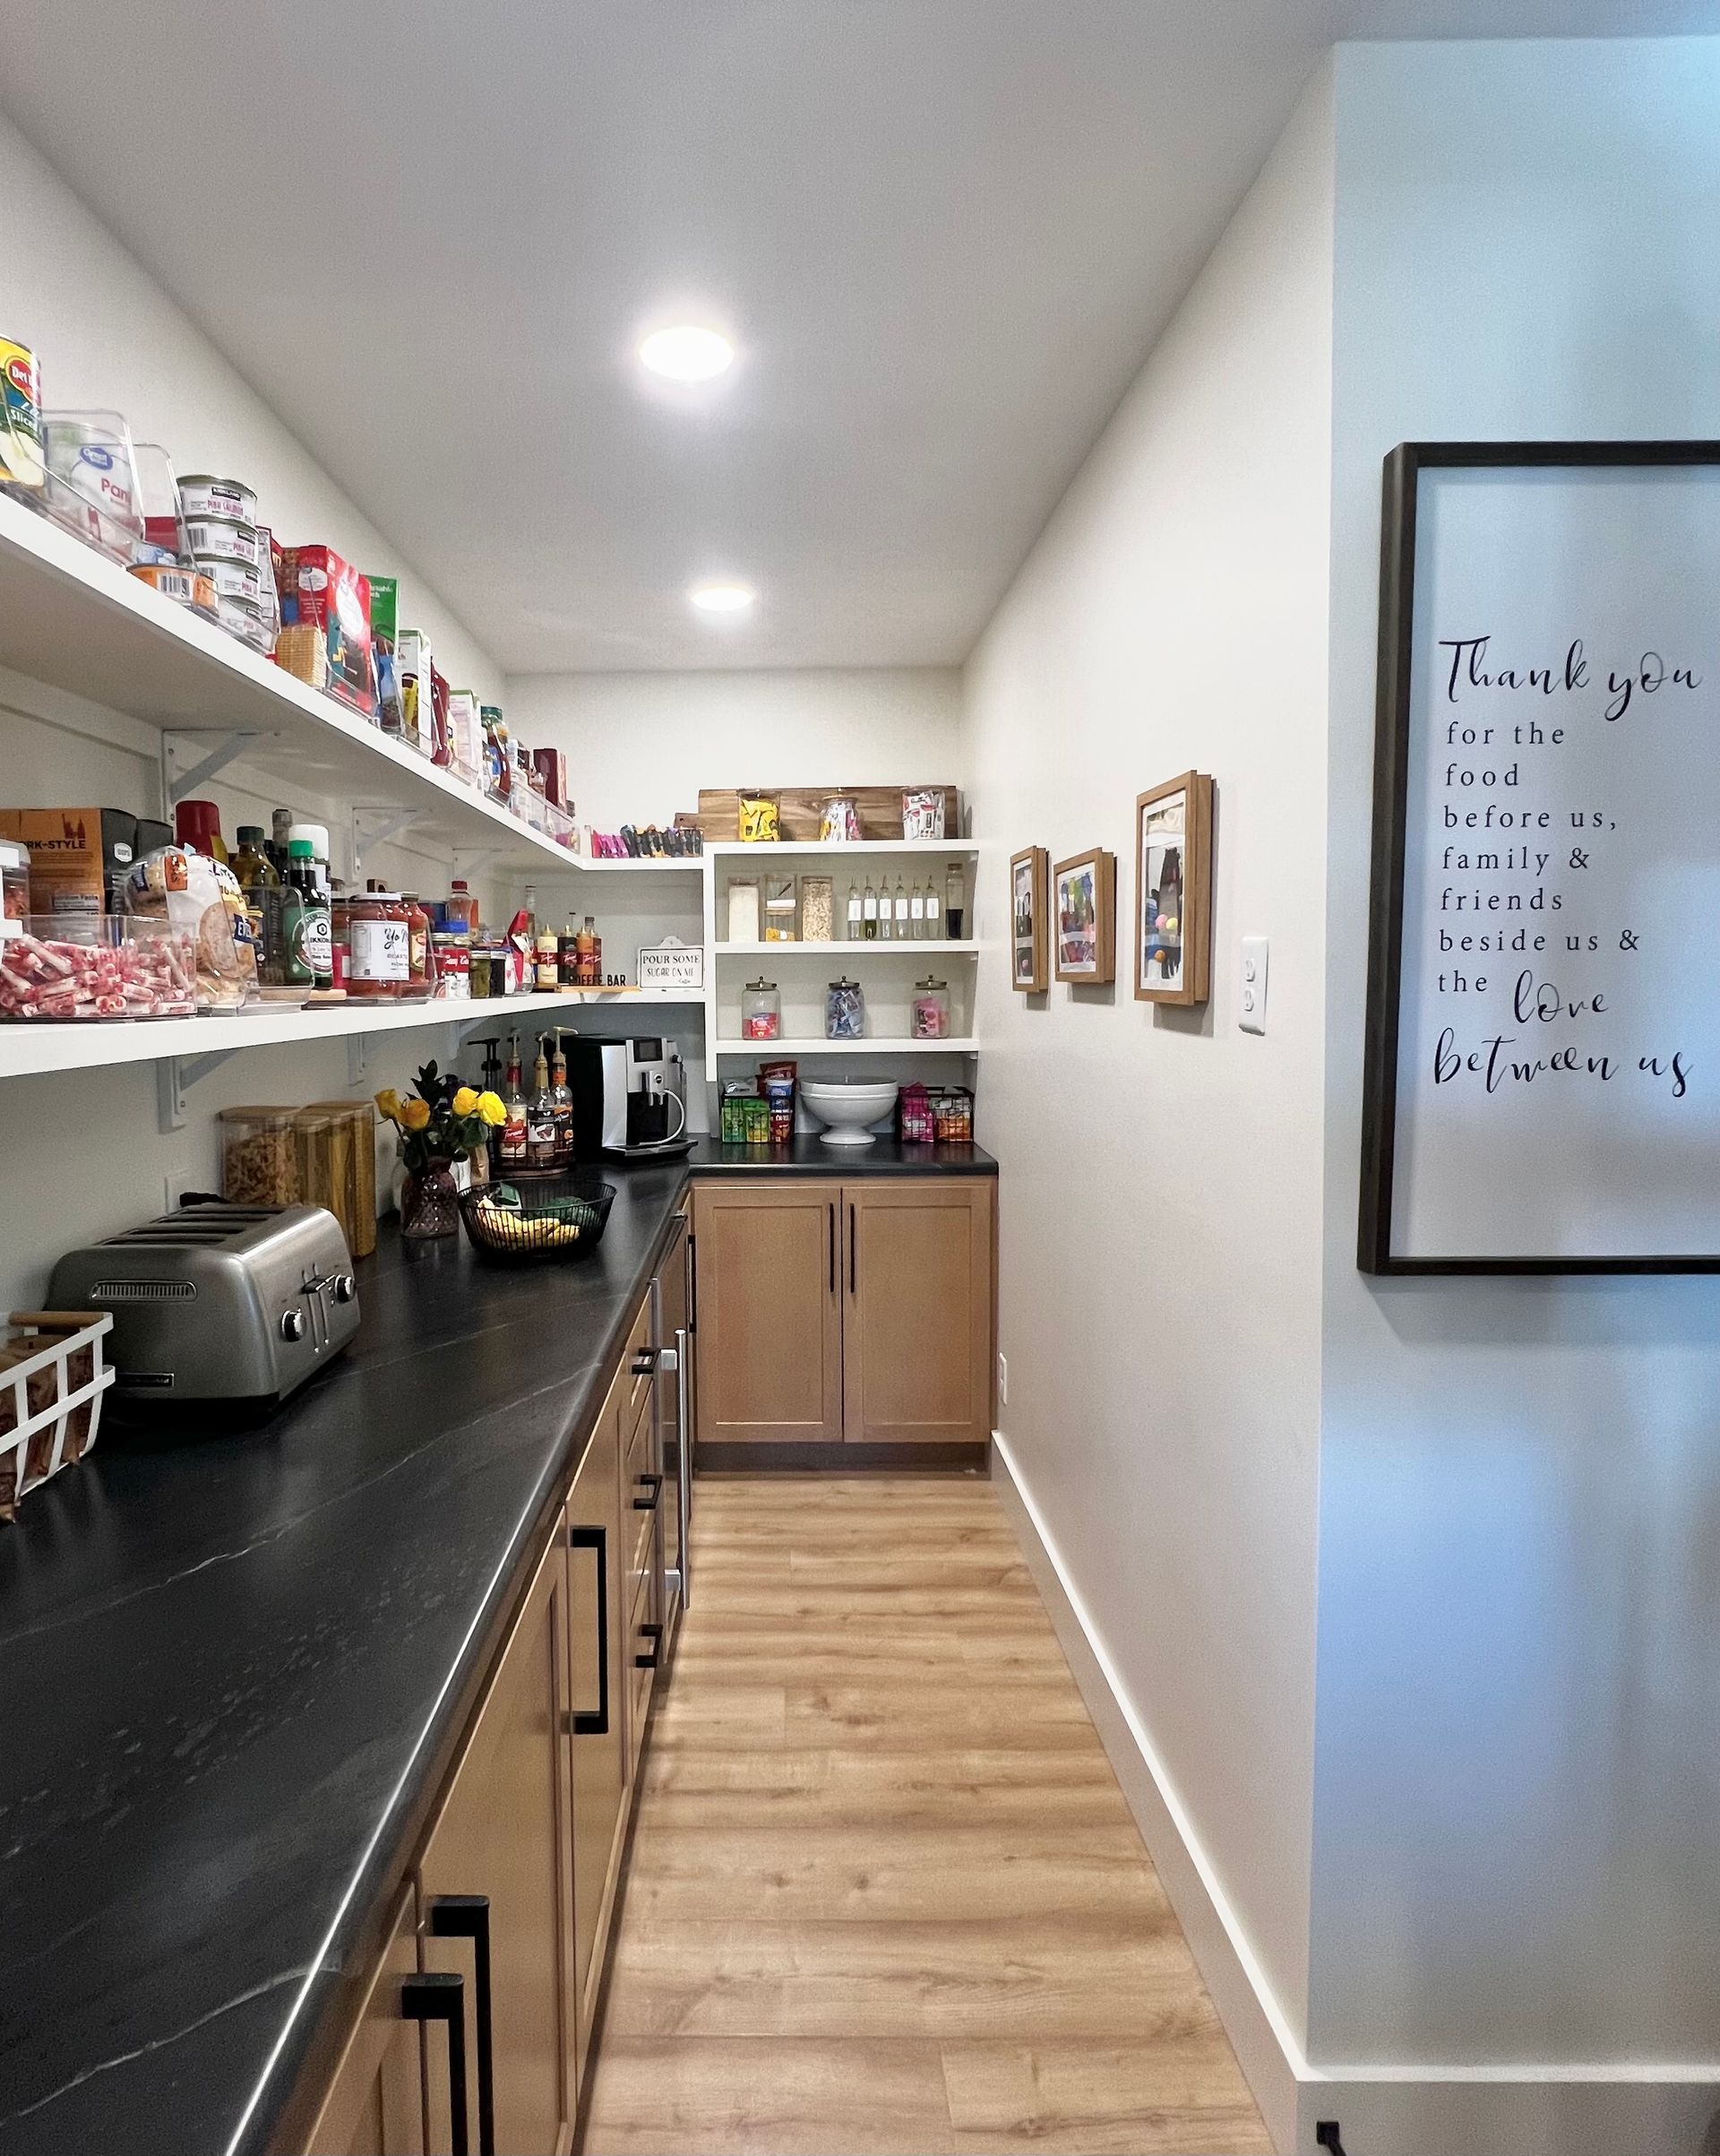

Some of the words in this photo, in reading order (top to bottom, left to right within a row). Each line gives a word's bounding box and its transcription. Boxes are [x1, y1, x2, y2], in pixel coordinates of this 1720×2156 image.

[1439, 636, 1590, 703] Thank
[1604, 651, 1702, 721] you
[1446, 721, 1495, 746] for
[1514, 721, 1565, 746] the
[1445, 763, 1519, 787] food
[1444, 806, 1551, 829] before
[1570, 810, 1618, 831] us,
[1442, 847, 1550, 876] family
[1569, 848, 1589, 869] &
[1440, 888, 1562, 911] friends
[1440, 929, 1545, 952] beside
[1566, 934, 1599, 952] us
[1619, 929, 1639, 952] &
[642, 955, 670, 964] POUR
[672, 955, 700, 963] SOME
[607, 974, 626, 987] BAR
[1438, 971, 1488, 993] the
[1514, 970, 1609, 1023] love
[1433, 1028, 1619, 1093] between
[1638, 1049, 1693, 1099] us
